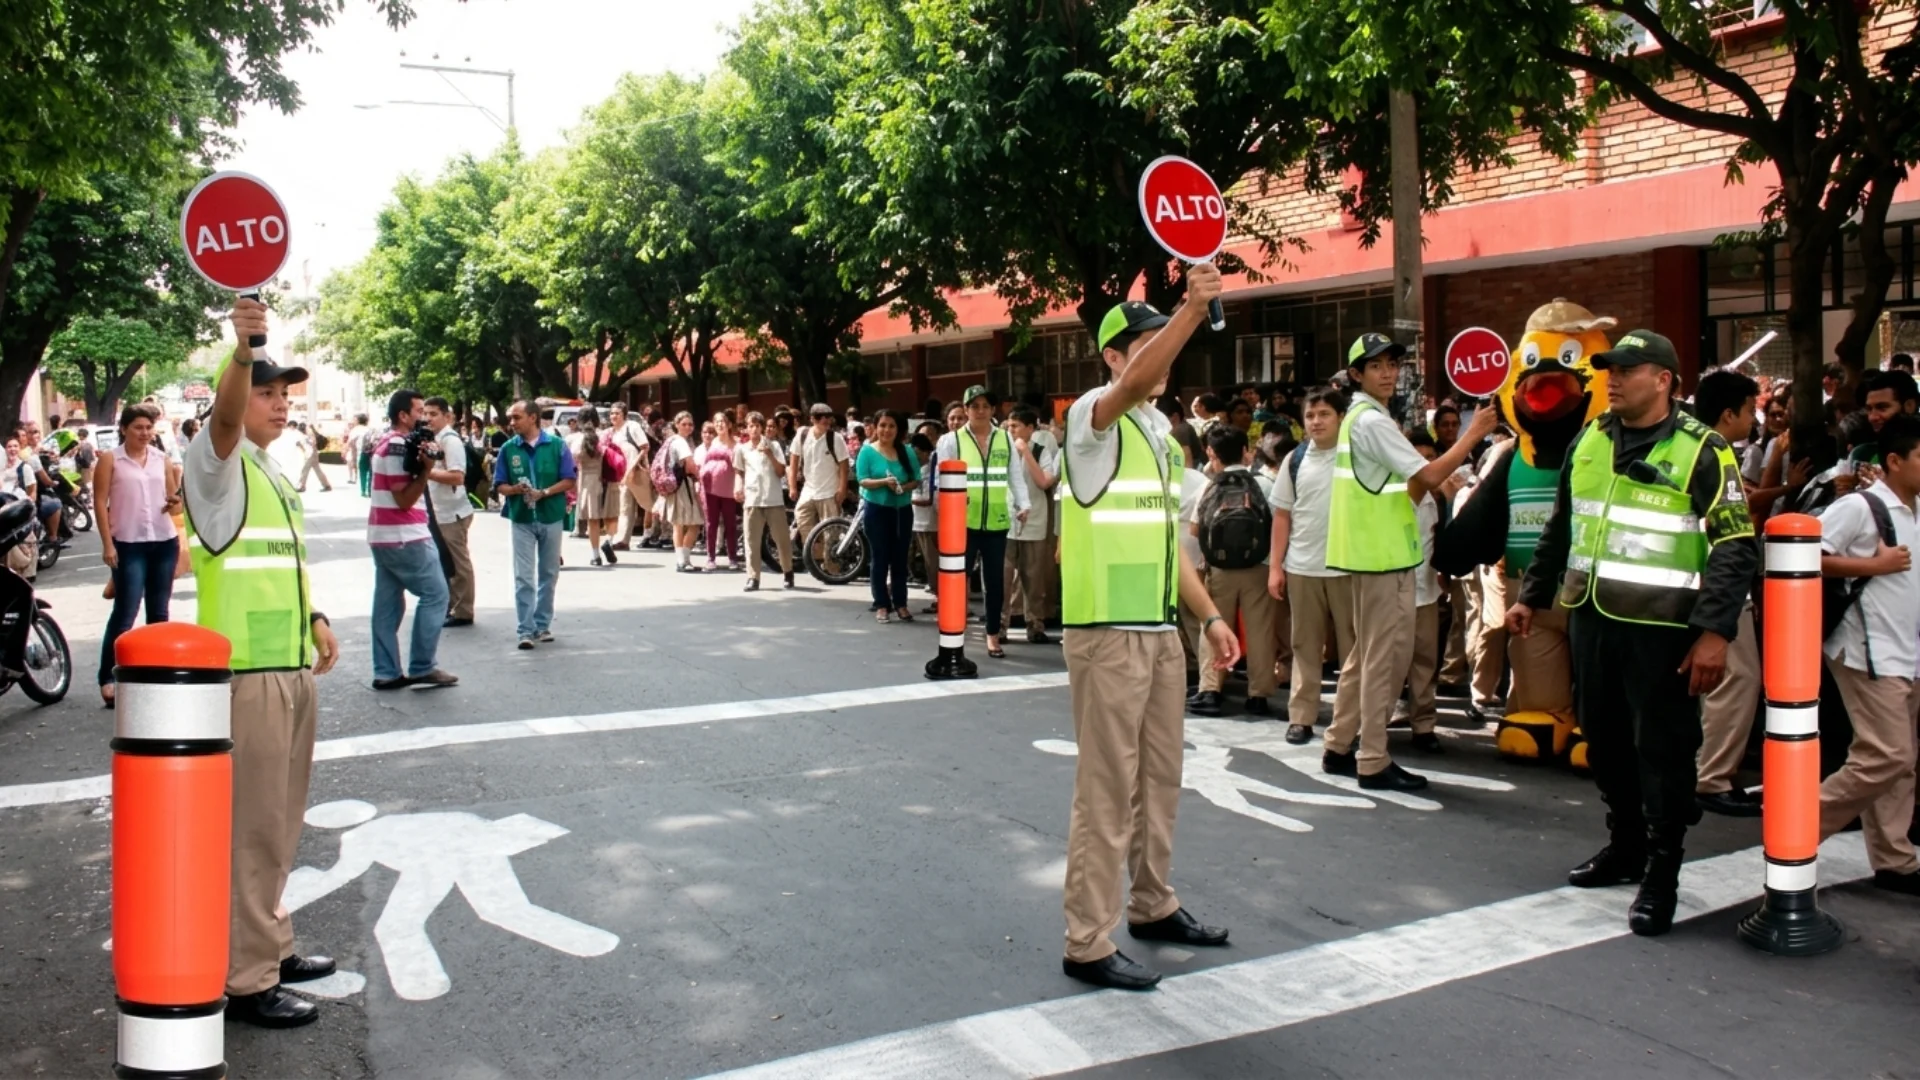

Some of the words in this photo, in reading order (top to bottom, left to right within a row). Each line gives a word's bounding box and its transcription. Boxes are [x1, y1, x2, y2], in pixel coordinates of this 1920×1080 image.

[1155, 194, 1223, 223] ALTO
[195, 214, 285, 256] ALTO
[1453, 350, 1507, 376] ALTO
